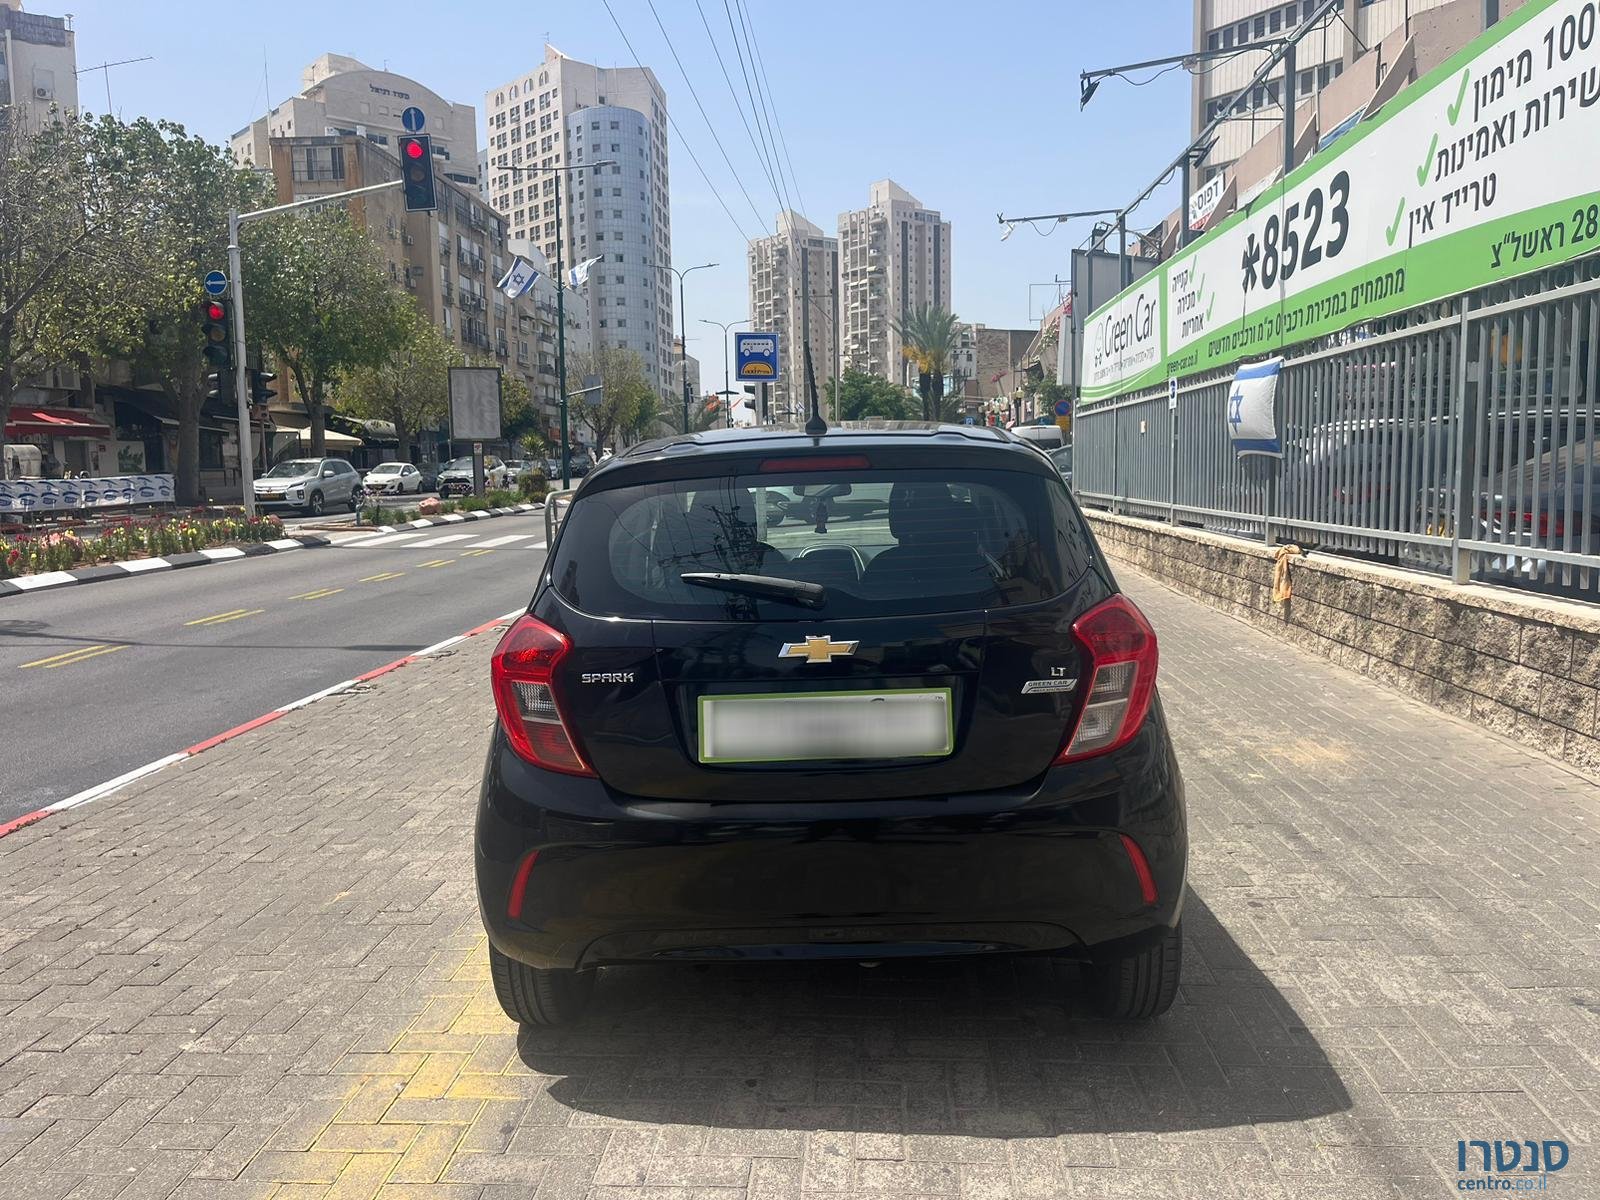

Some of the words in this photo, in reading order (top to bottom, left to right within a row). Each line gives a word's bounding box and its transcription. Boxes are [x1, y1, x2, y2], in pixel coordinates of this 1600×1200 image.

[1543, 0, 1600, 71] 100
[1474, 49, 1533, 123] מימון
[1523, 66, 1600, 139] שירות
[1435, 110, 1516, 182] ואמינות
[1197, 180, 1219, 211] דפוס
[1441, 172, 1498, 224] טרייד
[1408, 200, 1436, 249] אין
[1571, 204, 1599, 244] 28
[1177, 290, 1196, 316] מכירה
[1351, 268, 1405, 309] מתמחים
[1104, 314, 1133, 358] Green
[1135, 293, 1157, 342] Car
[1182, 312, 1204, 339] אחריות
[1306, 291, 1347, 327] במכירת
[1208, 336, 1231, 357] חדשים
[1232, 325, 1256, 350] ורכבים
[581, 672, 634, 684] SPARK
[1051, 666, 1066, 677] LT
